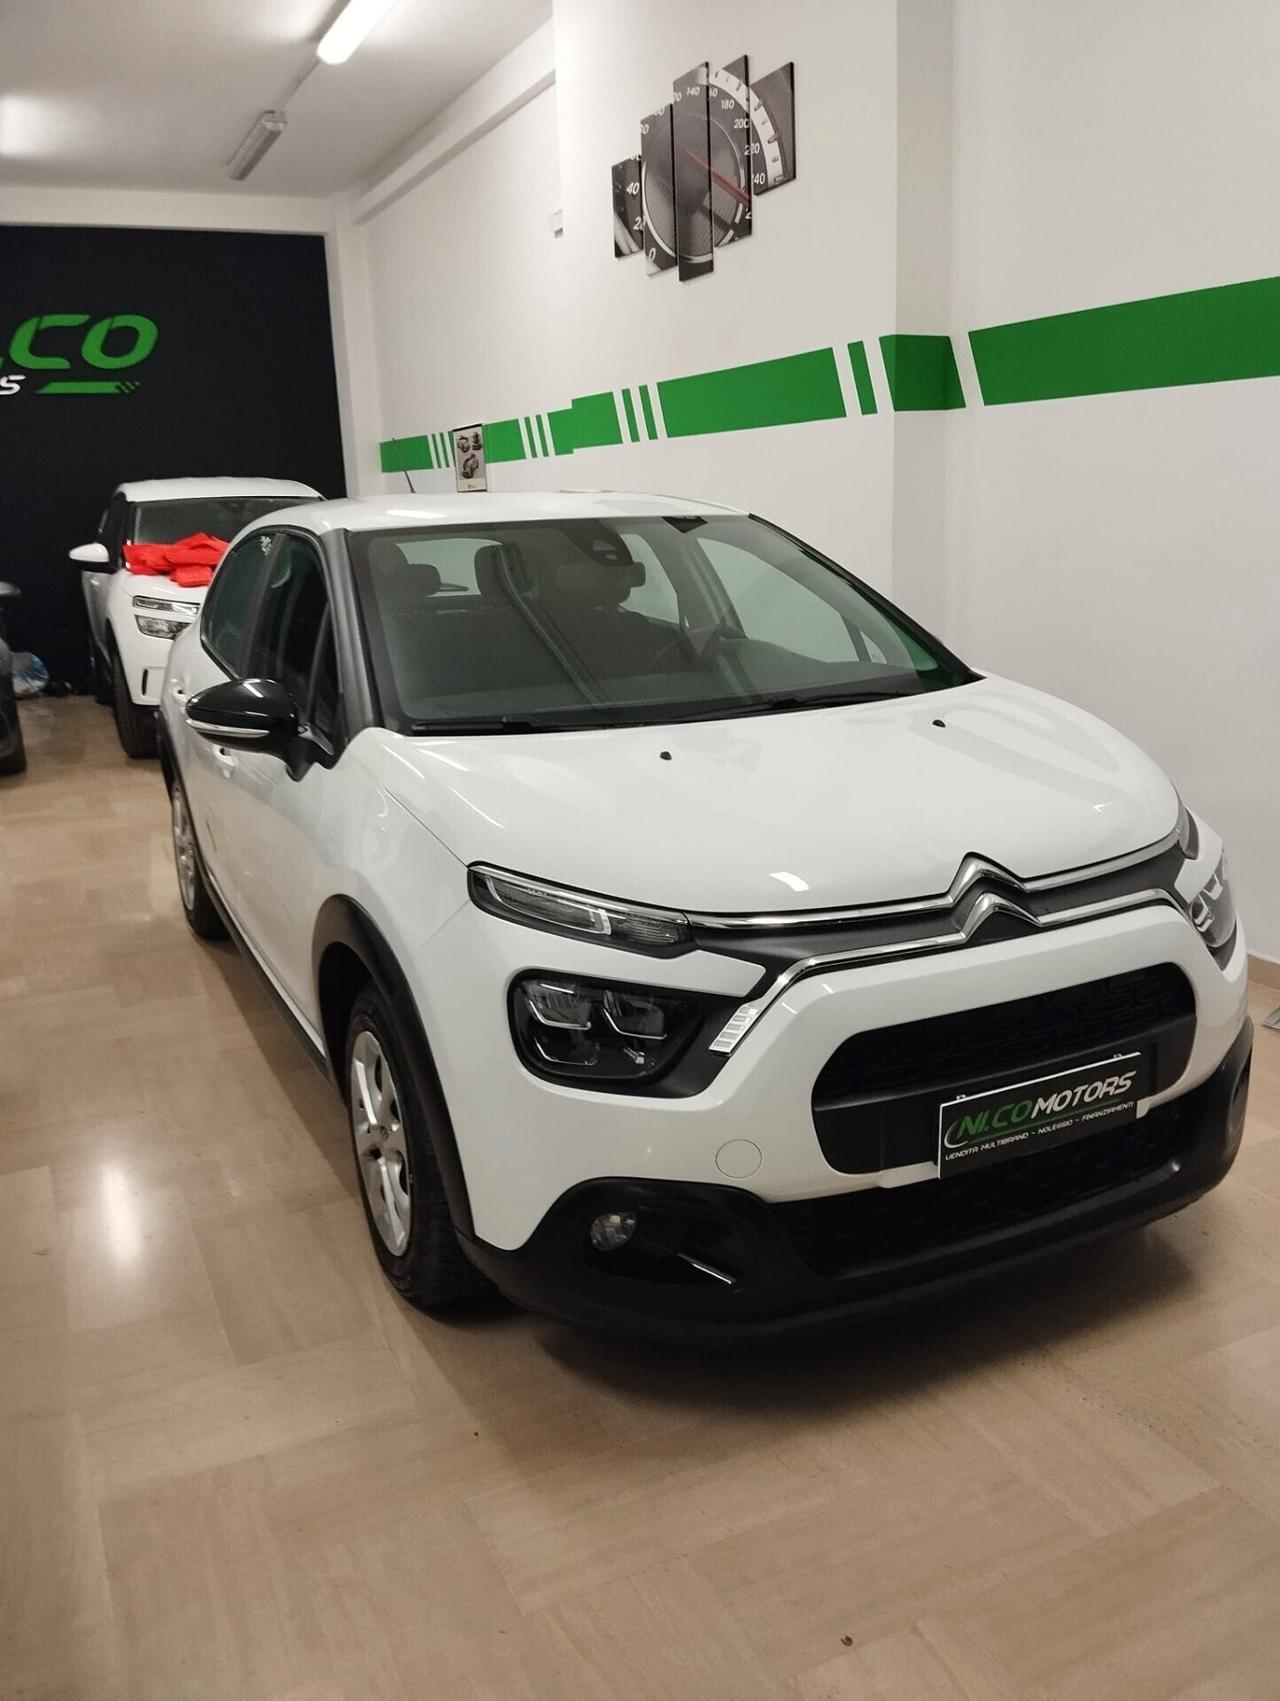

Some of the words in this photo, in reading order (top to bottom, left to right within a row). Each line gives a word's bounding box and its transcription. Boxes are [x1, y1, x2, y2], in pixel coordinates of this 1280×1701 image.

[686, 86, 700, 96] 140
[733, 118, 750, 129] 200
[752, 172, 766, 185] 40
[625, 182, 640, 195] 40
[0, 313, 159, 370] CO
[945, 1146, 978, 1161] VENDITA
[980, 1132, 1029, 1151] MULTIBRAND
[1037, 1119, 1074, 1135] NOLEGGIO
